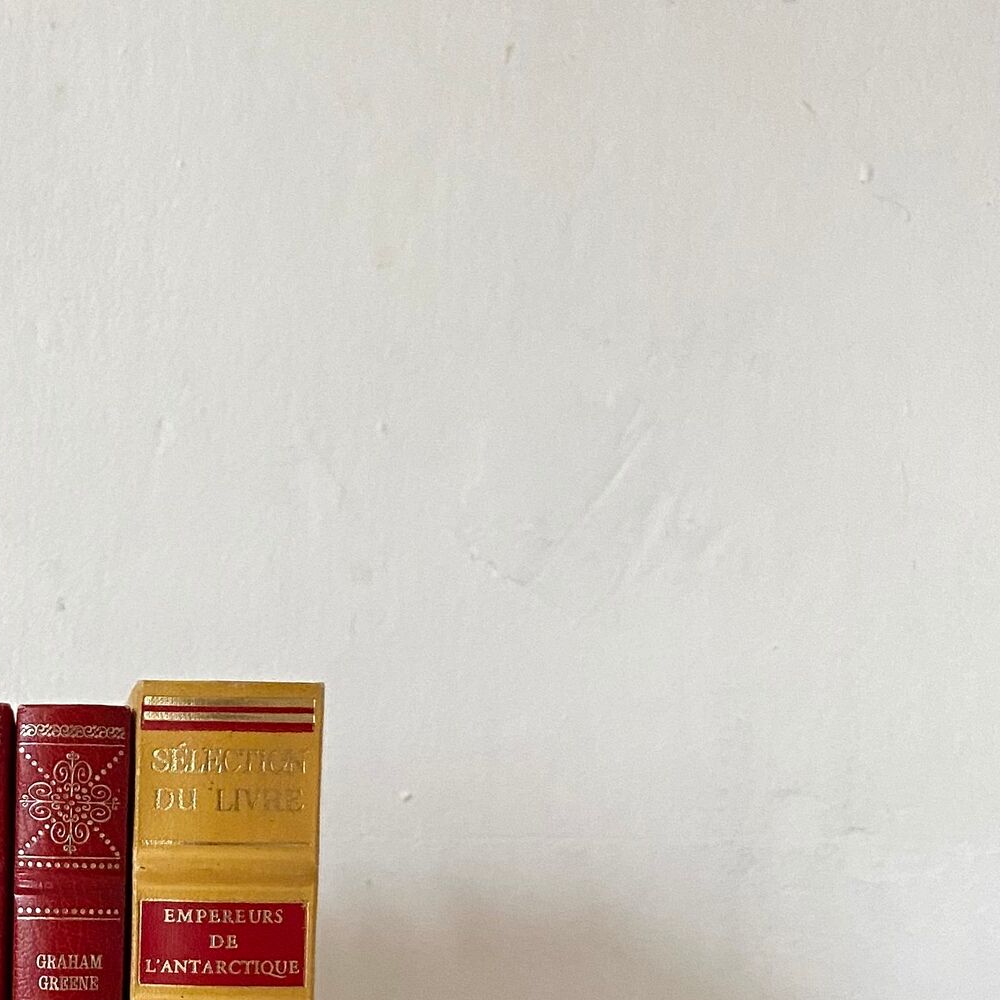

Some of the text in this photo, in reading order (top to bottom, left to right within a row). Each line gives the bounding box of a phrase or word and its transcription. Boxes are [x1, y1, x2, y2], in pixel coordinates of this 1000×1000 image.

[155, 787, 198, 811] DU
[164, 909, 284, 924] EMPEREURS
[209, 935, 238, 949] DE
[36, 954, 103, 970] GRAHAM
[145, 959, 300, 979] L'ANTARCTIQUE
[38, 975, 99, 991] GREENE
